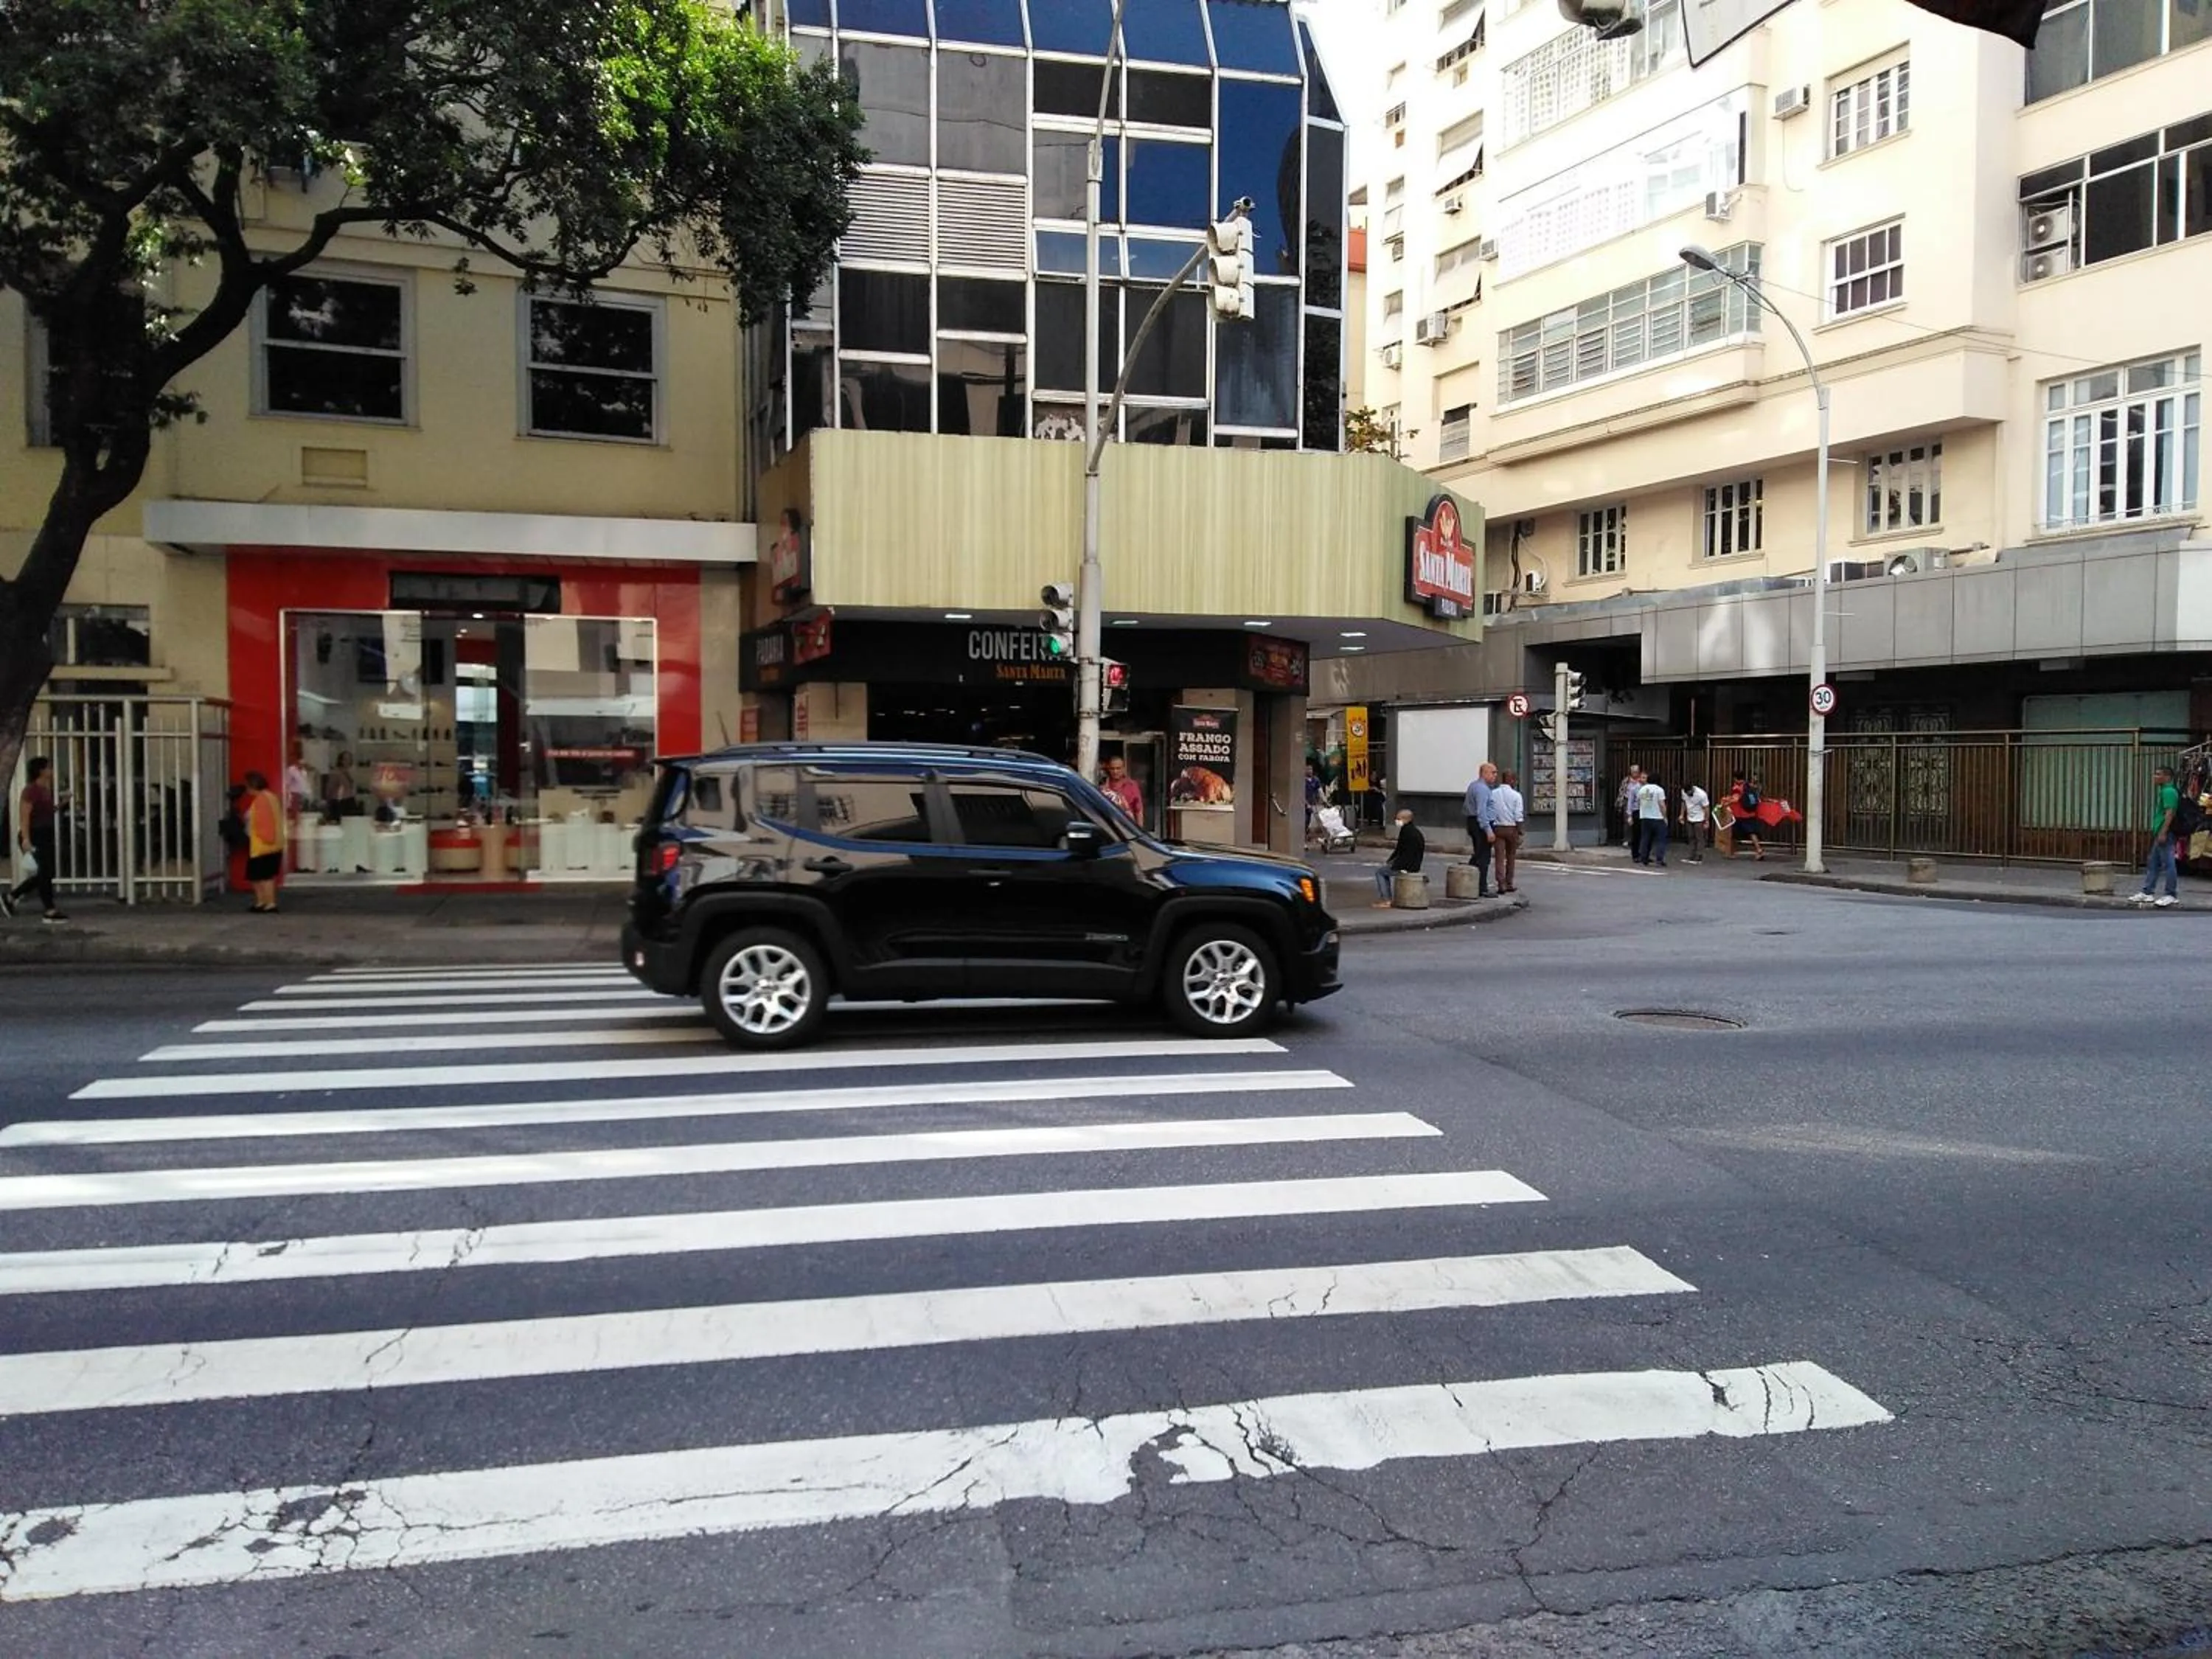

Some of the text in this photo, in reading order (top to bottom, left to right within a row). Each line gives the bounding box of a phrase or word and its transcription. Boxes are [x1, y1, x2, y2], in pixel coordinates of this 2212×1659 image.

[968, 630, 1062, 661] CONFEI
[1815, 691, 1832, 705] 30
[1179, 732, 1231, 744] FRANGO
[1179, 742, 1231, 754] ASSADO
